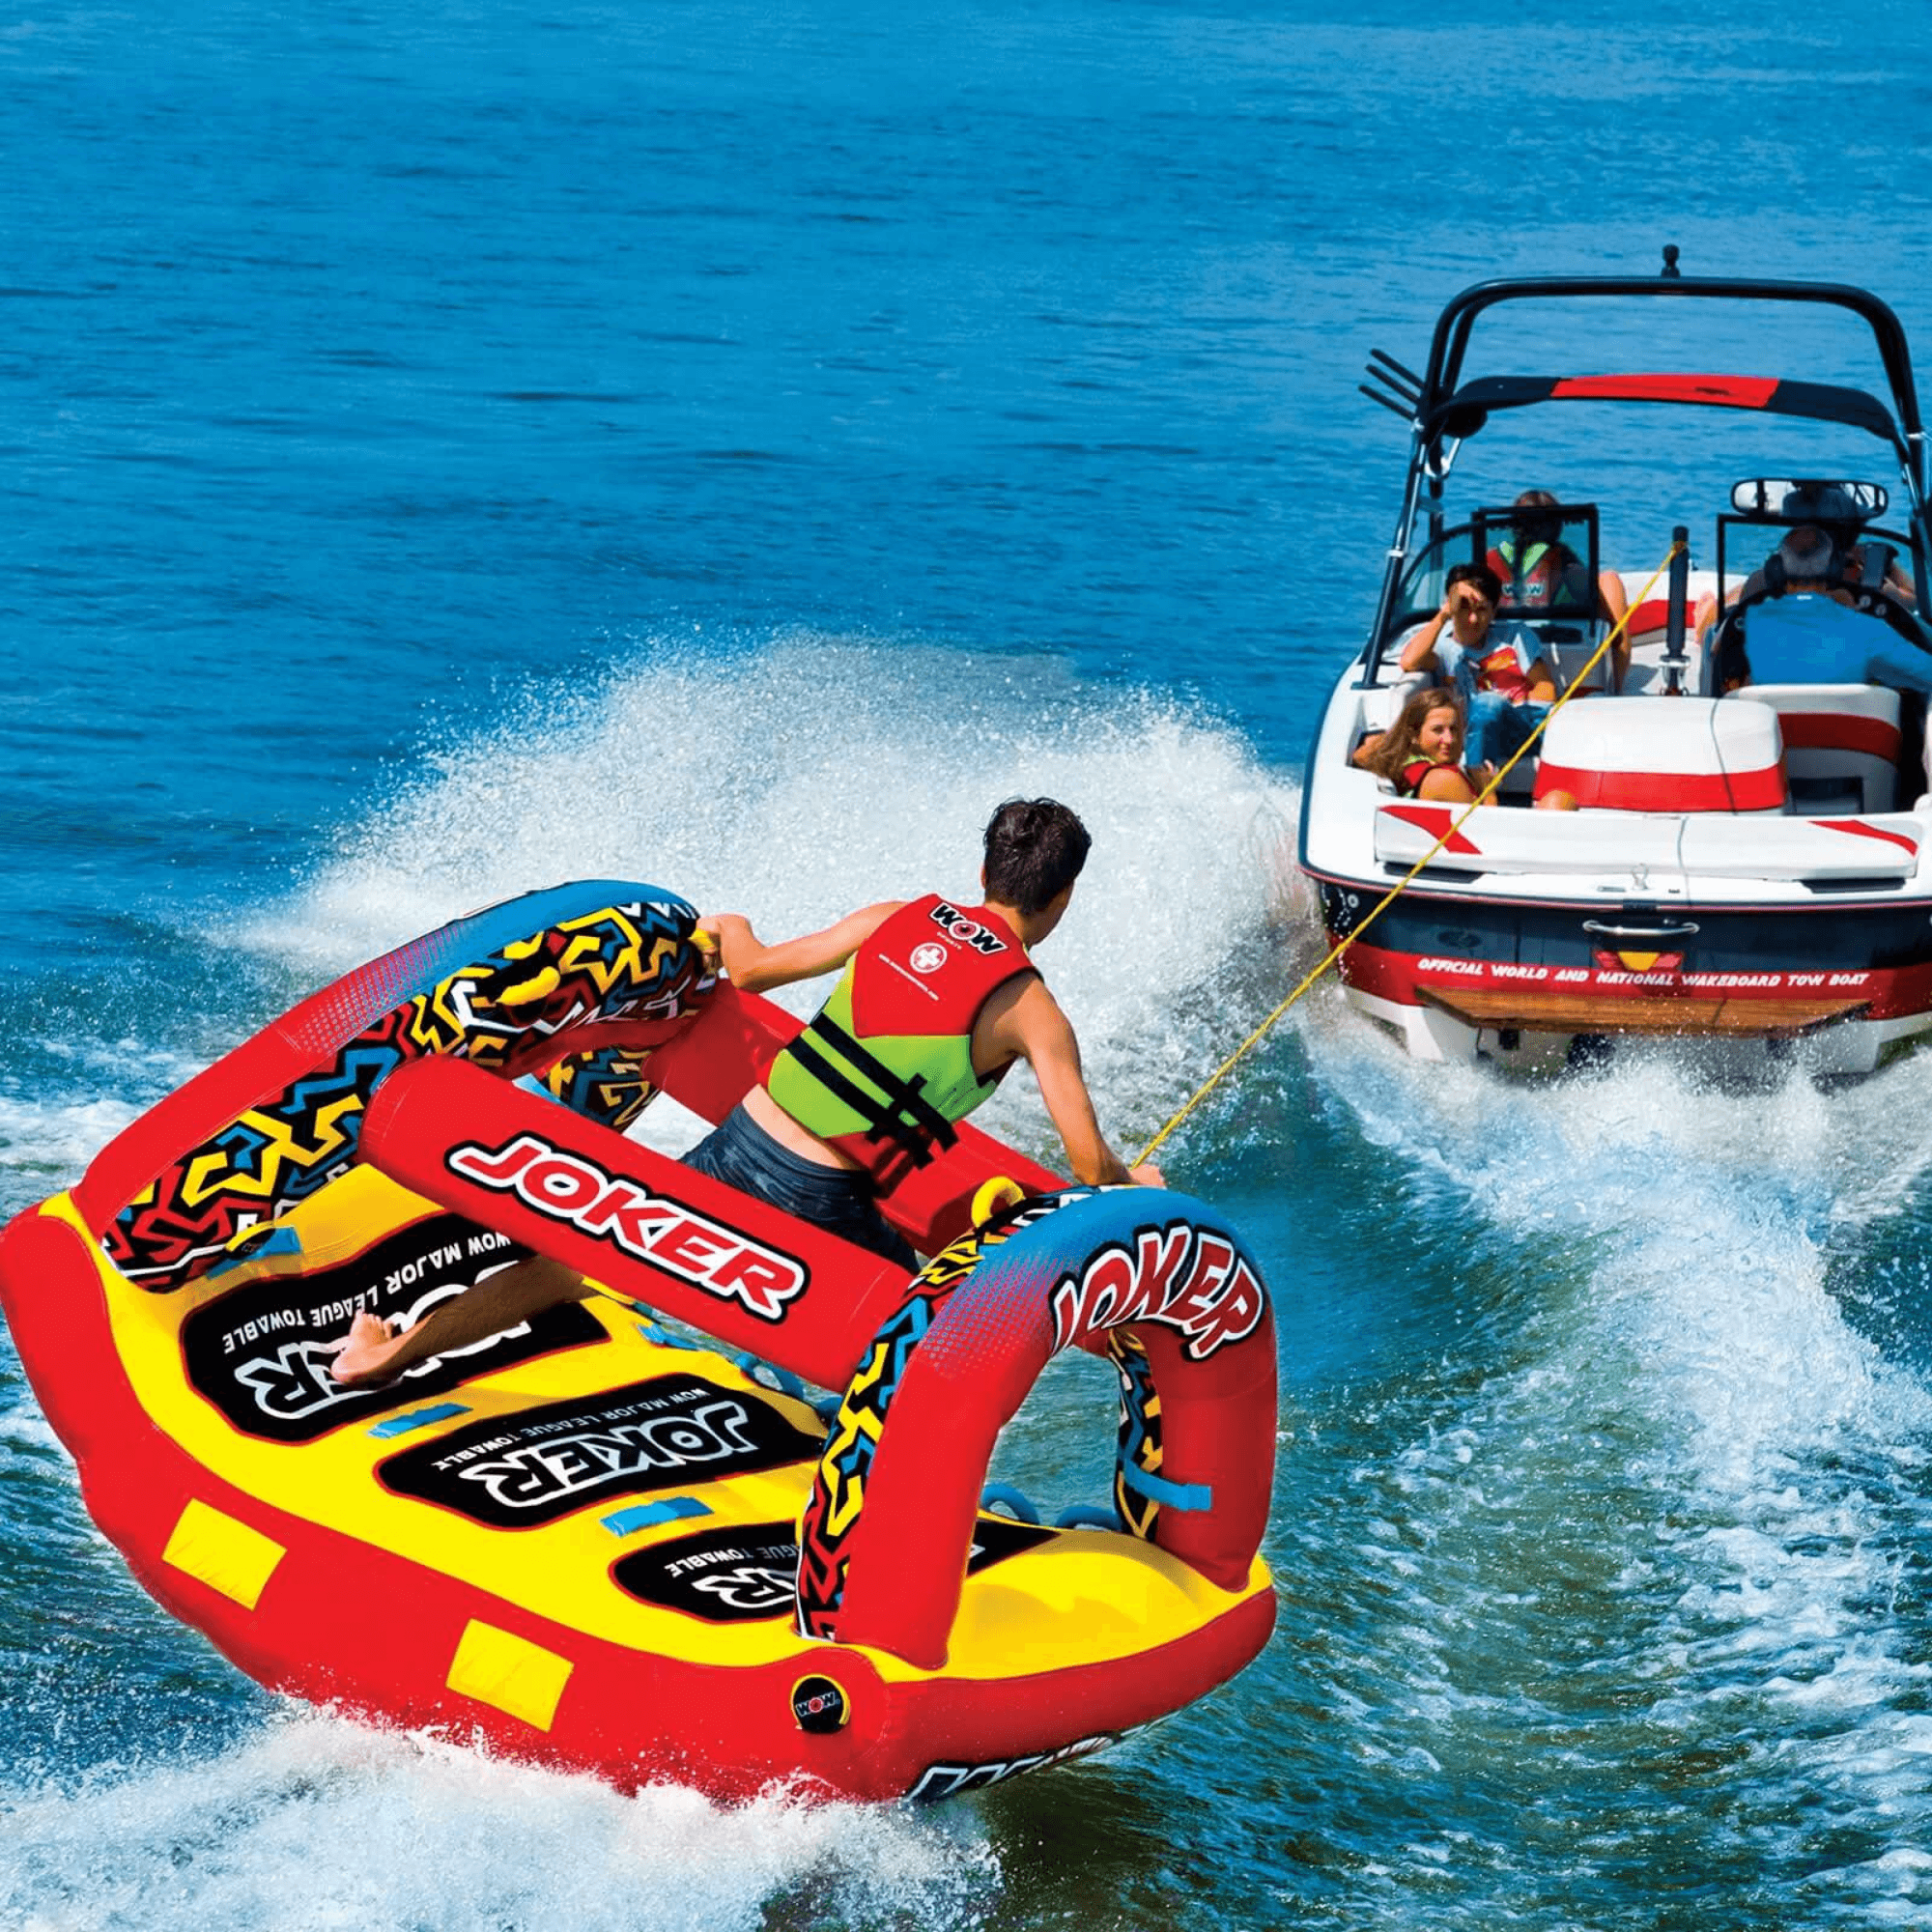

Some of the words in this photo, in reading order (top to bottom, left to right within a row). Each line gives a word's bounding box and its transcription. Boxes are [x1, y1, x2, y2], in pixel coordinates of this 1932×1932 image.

[1501, 582, 1545, 597] WW
[929, 901, 1009, 954] WOW
[1417, 957, 1484, 976] OFFICIAL
[1490, 964, 1548, 980] WORLD
[1554, 969, 1590, 982] AND
[1596, 971, 1675, 986] NATIONAL
[1681, 974, 1782, 987] WAKEBOARD
[1787, 974, 1826, 986] TOW
[1829, 973, 1871, 986] BOAT
[447, 1134, 807, 1321] JOKER
[468, 1232, 512, 1256] WOW
[384, 1242, 463, 1294] MAJOR
[311, 1285, 380, 1328] LEAGUE
[1051, 1225, 1264, 1360] JOKER
[222, 1309, 306, 1353] TOWABLE
[600, 1398, 670, 1420] MAJOR
[668, 1387, 712, 1405] WOW
[520, 1414, 601, 1437] LEAGUE
[430, 1433, 523, 1471] TOWABLE
[458, 1400, 760, 1509] JOKER
[664, 1548, 754, 1578] TOWABLE
[756, 1544, 801, 1559] GUE
[795, 1690, 836, 1718] WOW
